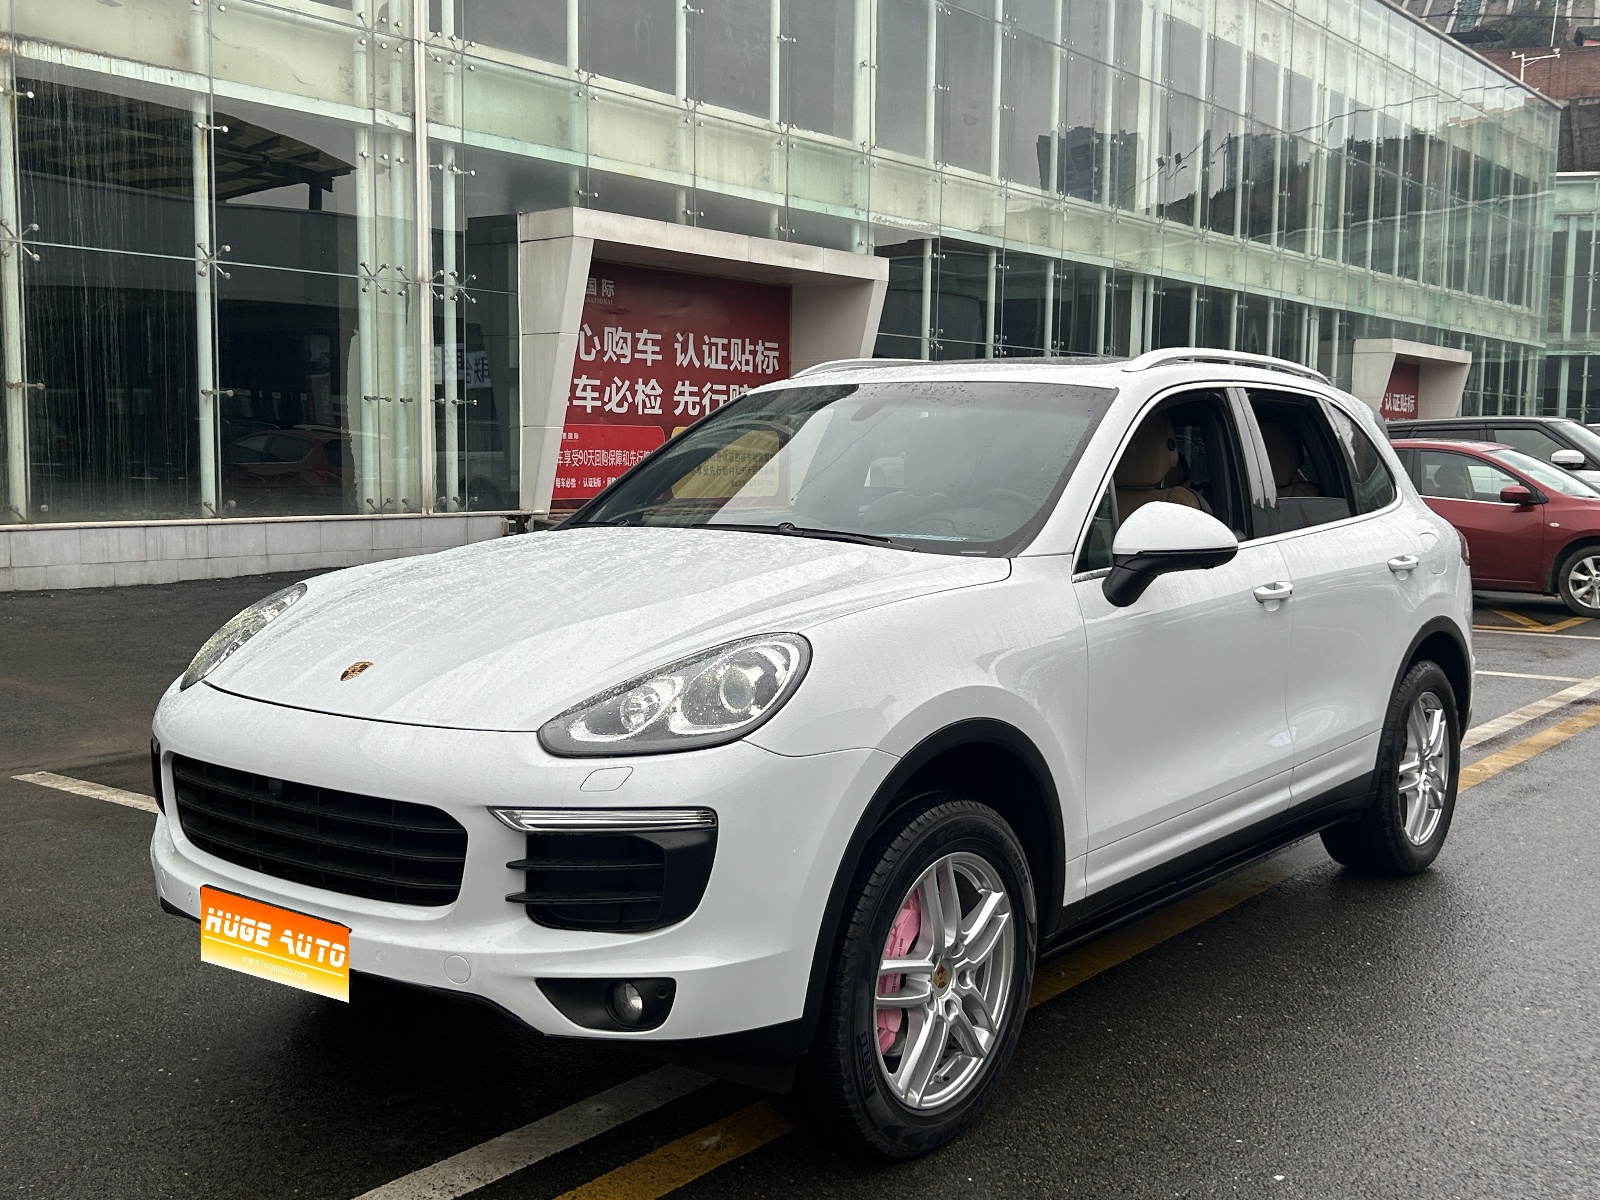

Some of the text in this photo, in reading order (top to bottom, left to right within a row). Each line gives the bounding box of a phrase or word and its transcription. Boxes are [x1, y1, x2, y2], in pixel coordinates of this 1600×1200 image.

[580, 323, 780, 374] 心购车 认证贴标
[568, 375, 663, 415] 车必检
